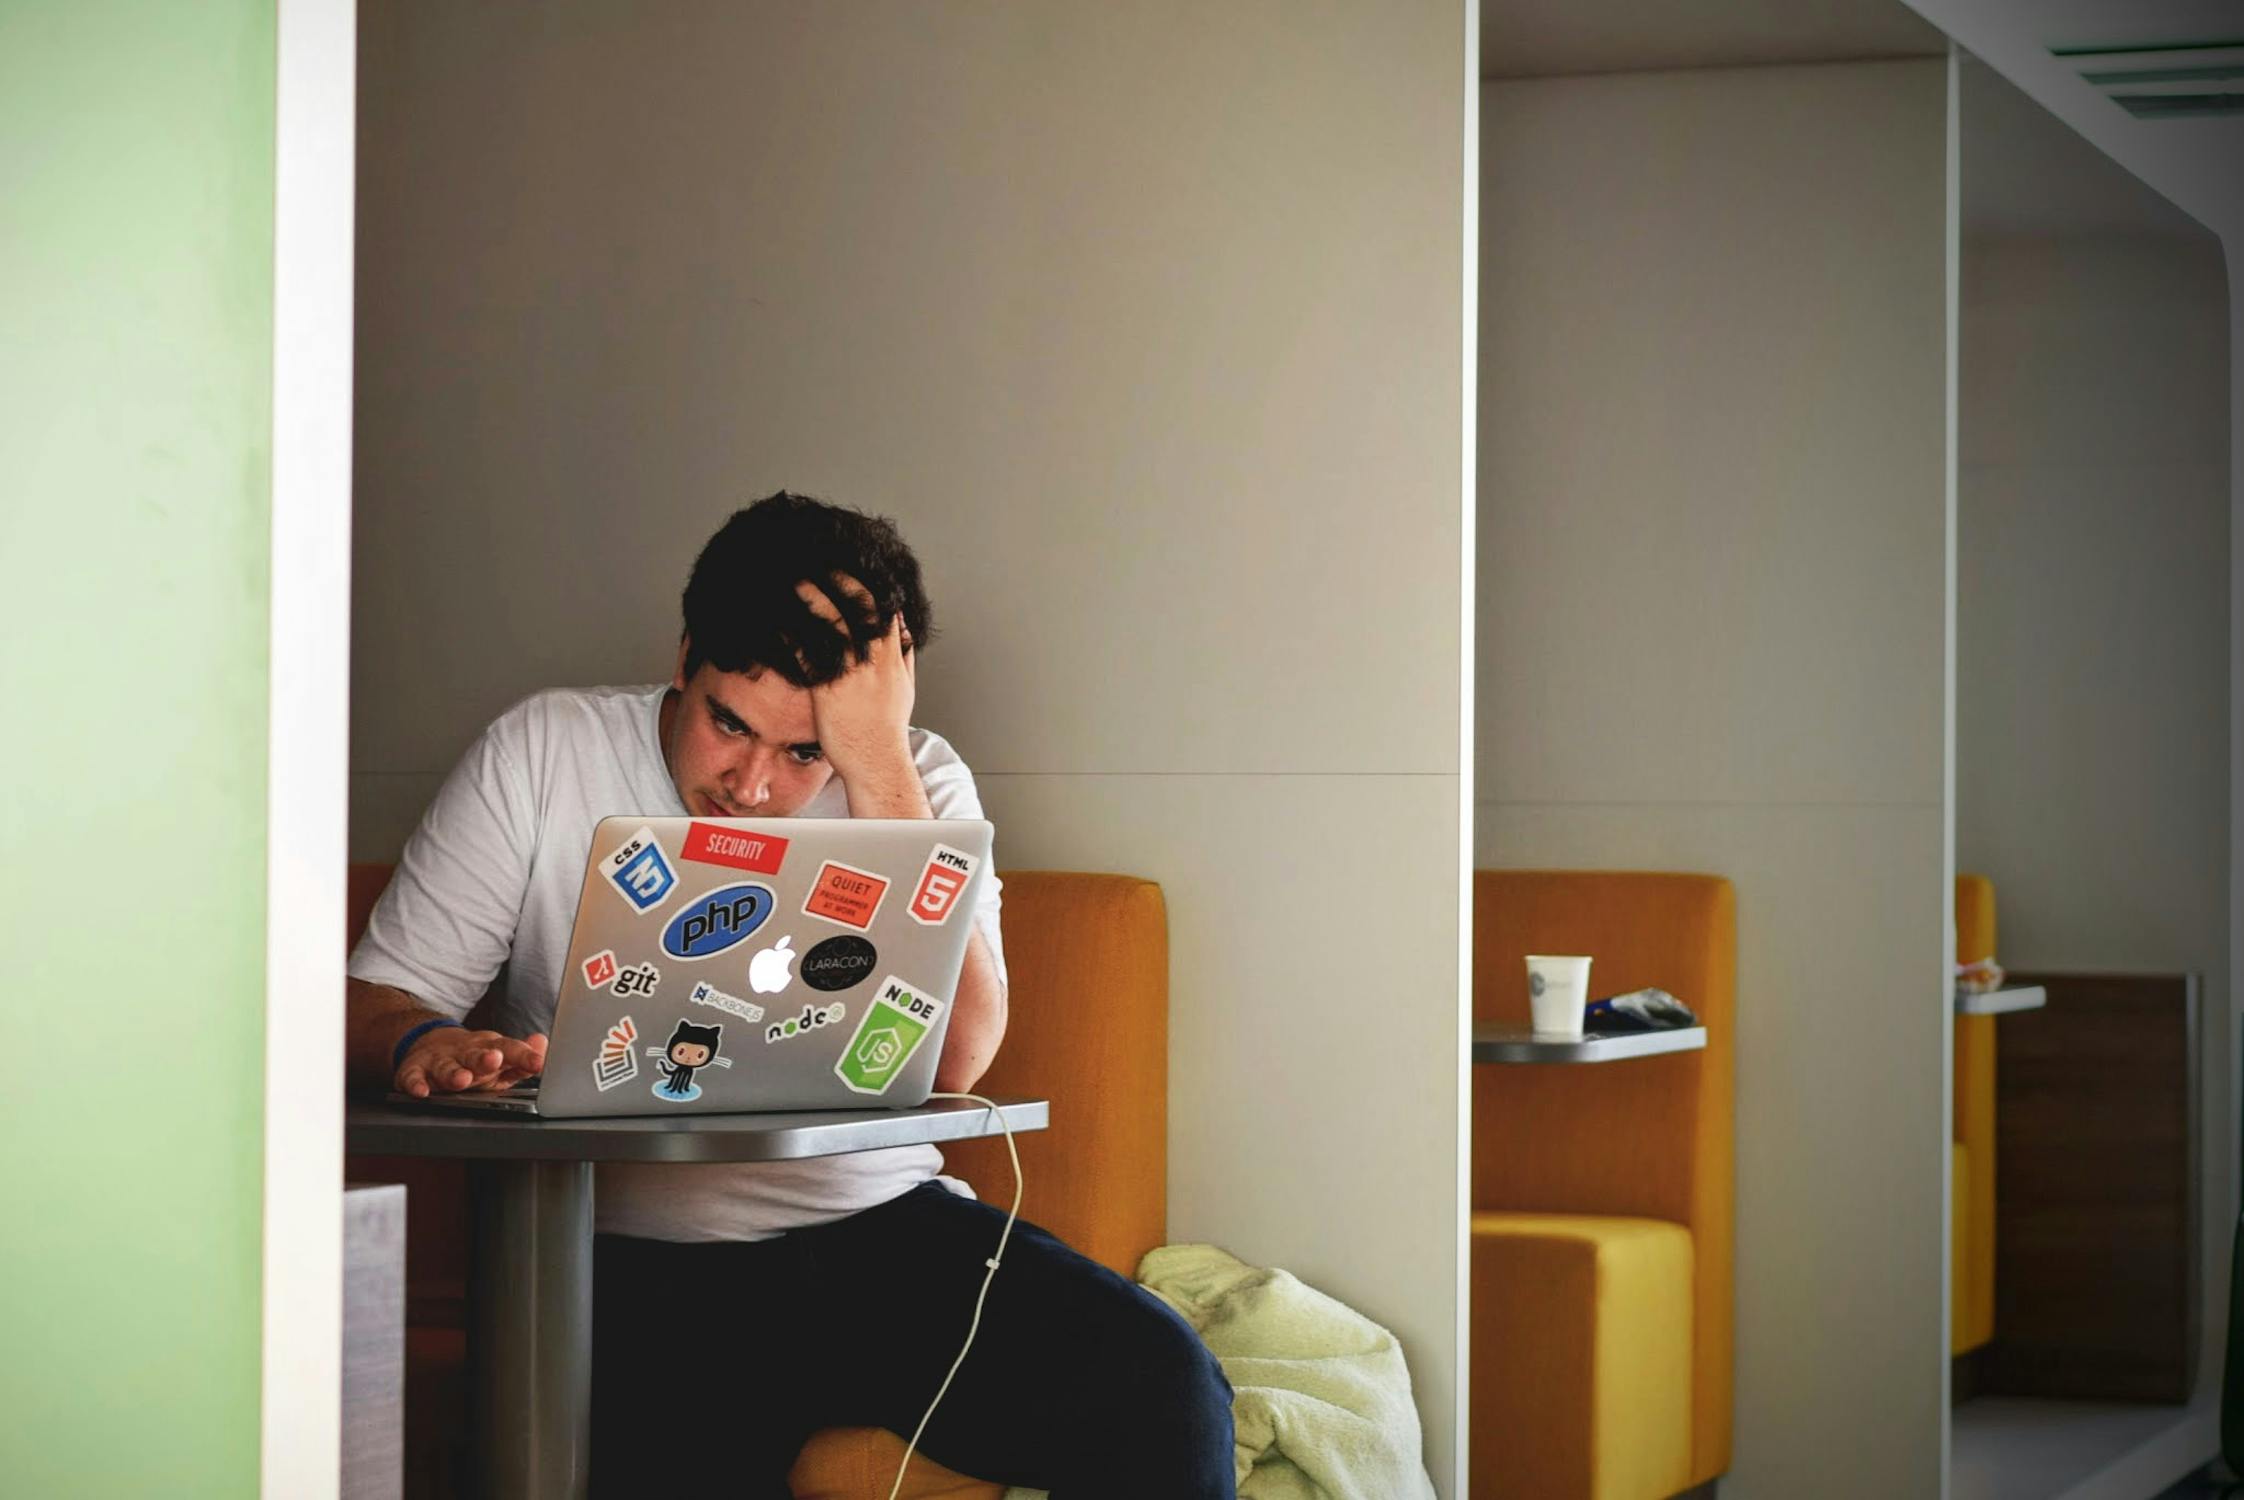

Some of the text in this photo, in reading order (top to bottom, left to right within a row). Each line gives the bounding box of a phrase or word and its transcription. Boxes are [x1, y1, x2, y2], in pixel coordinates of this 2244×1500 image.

[614, 840, 642, 865] CSS
[706, 833, 766, 860] SECURITY
[937, 851, 969, 871] HTML
[832, 876, 871, 895] QUIET
[920, 874, 957, 912] 5
[682, 894, 757, 952] php
[809, 955, 868, 971] LARACON
[614, 966, 657, 994] git
[885, 984, 935, 1019] NODE
